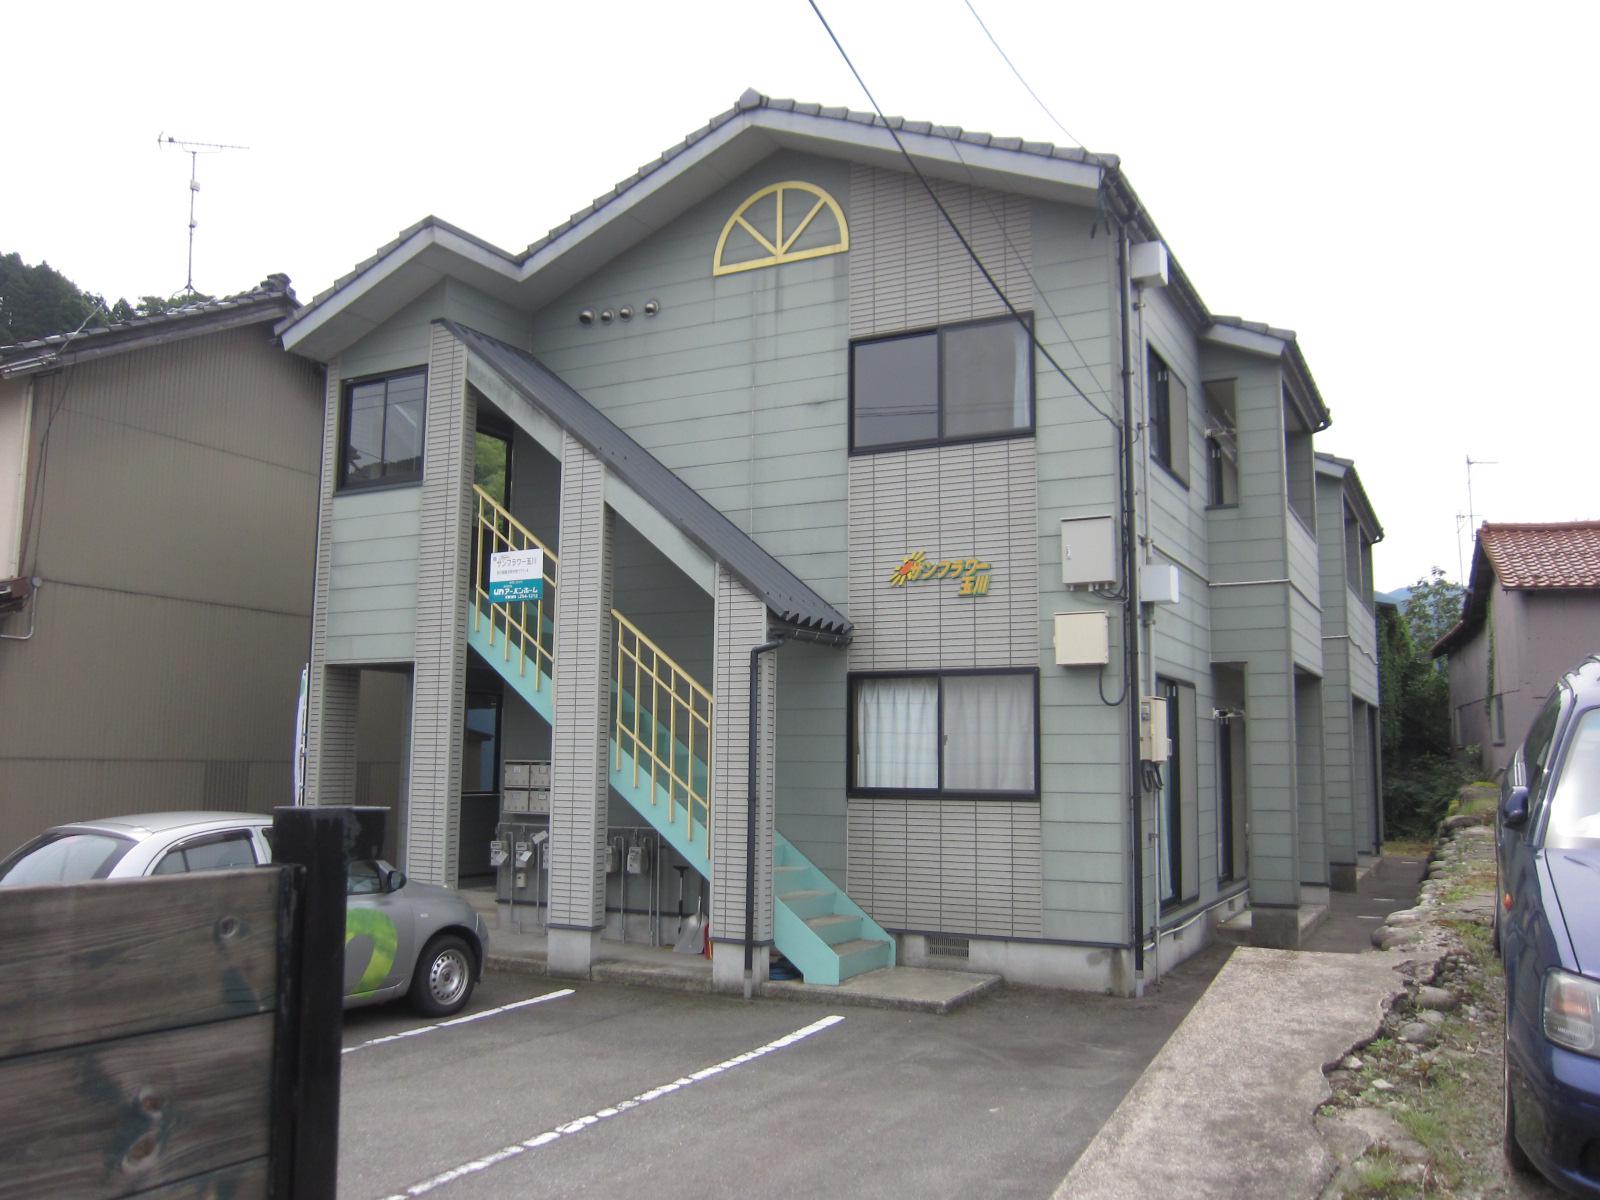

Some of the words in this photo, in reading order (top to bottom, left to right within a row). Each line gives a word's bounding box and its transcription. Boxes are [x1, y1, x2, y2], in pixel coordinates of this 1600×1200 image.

[905, 556, 991, 582] サンフラワー
[959, 575, 990, 596] 玉川
